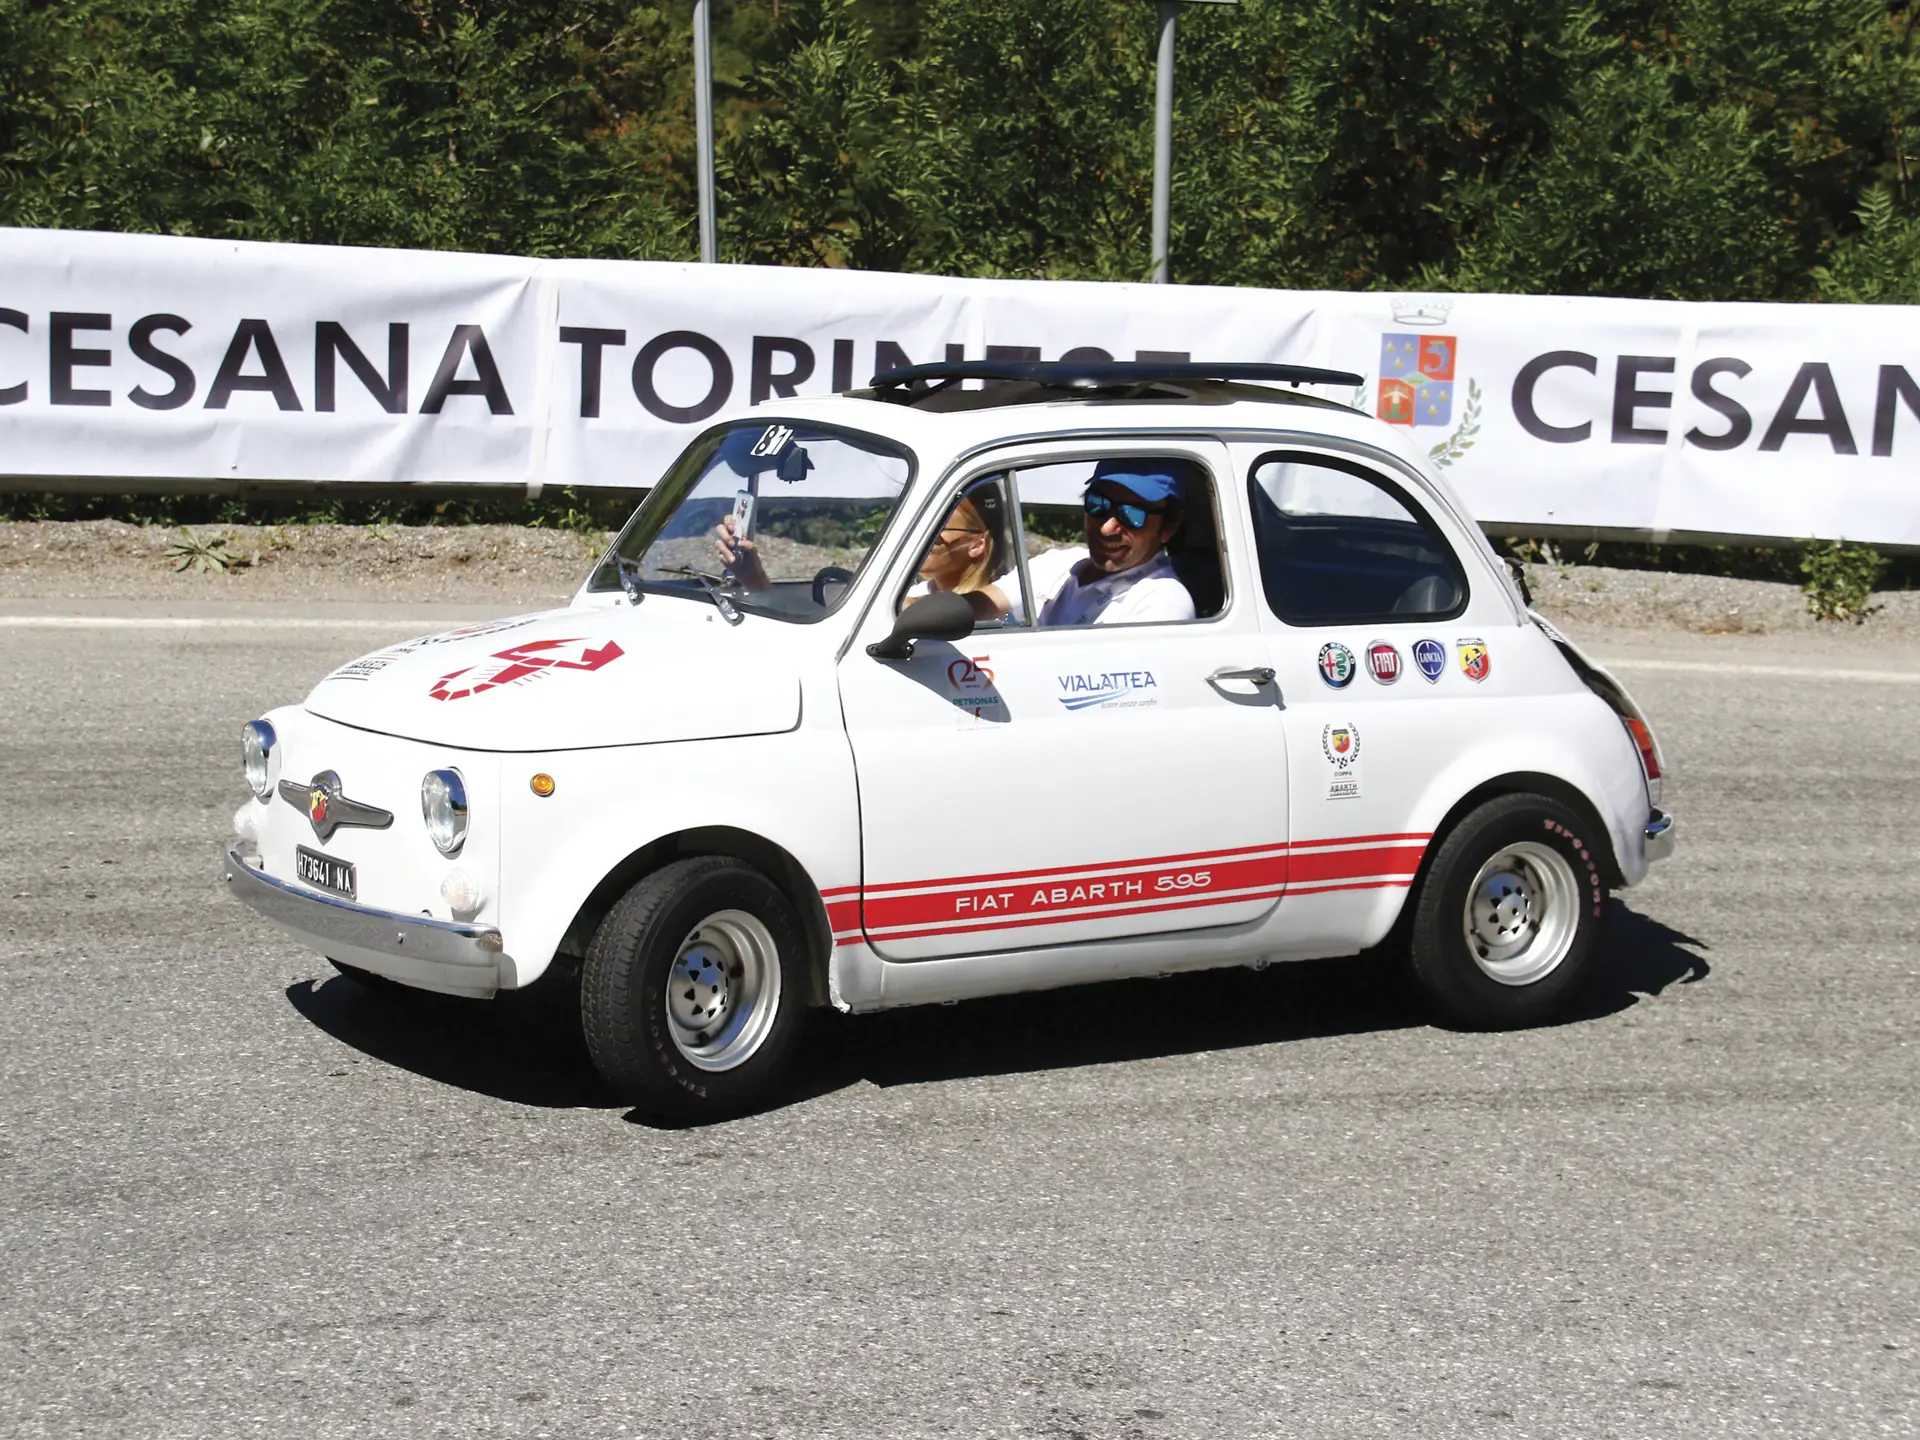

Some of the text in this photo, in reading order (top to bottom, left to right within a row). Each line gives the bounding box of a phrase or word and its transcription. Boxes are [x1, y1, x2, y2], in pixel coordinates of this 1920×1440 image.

[754, 424, 789, 455] 81
[1373, 651, 1396, 673] FIAT
[1419, 652, 1442, 664] LANCIA
[1058, 671, 1157, 692] VIALATTEA
[953, 696, 999, 706] PETRONAS
[1329, 784, 1358, 793] ABARTH
[297, 851, 351, 892] H73641 NA
[956, 872, 1212, 912] FIAT ABARTH 595
